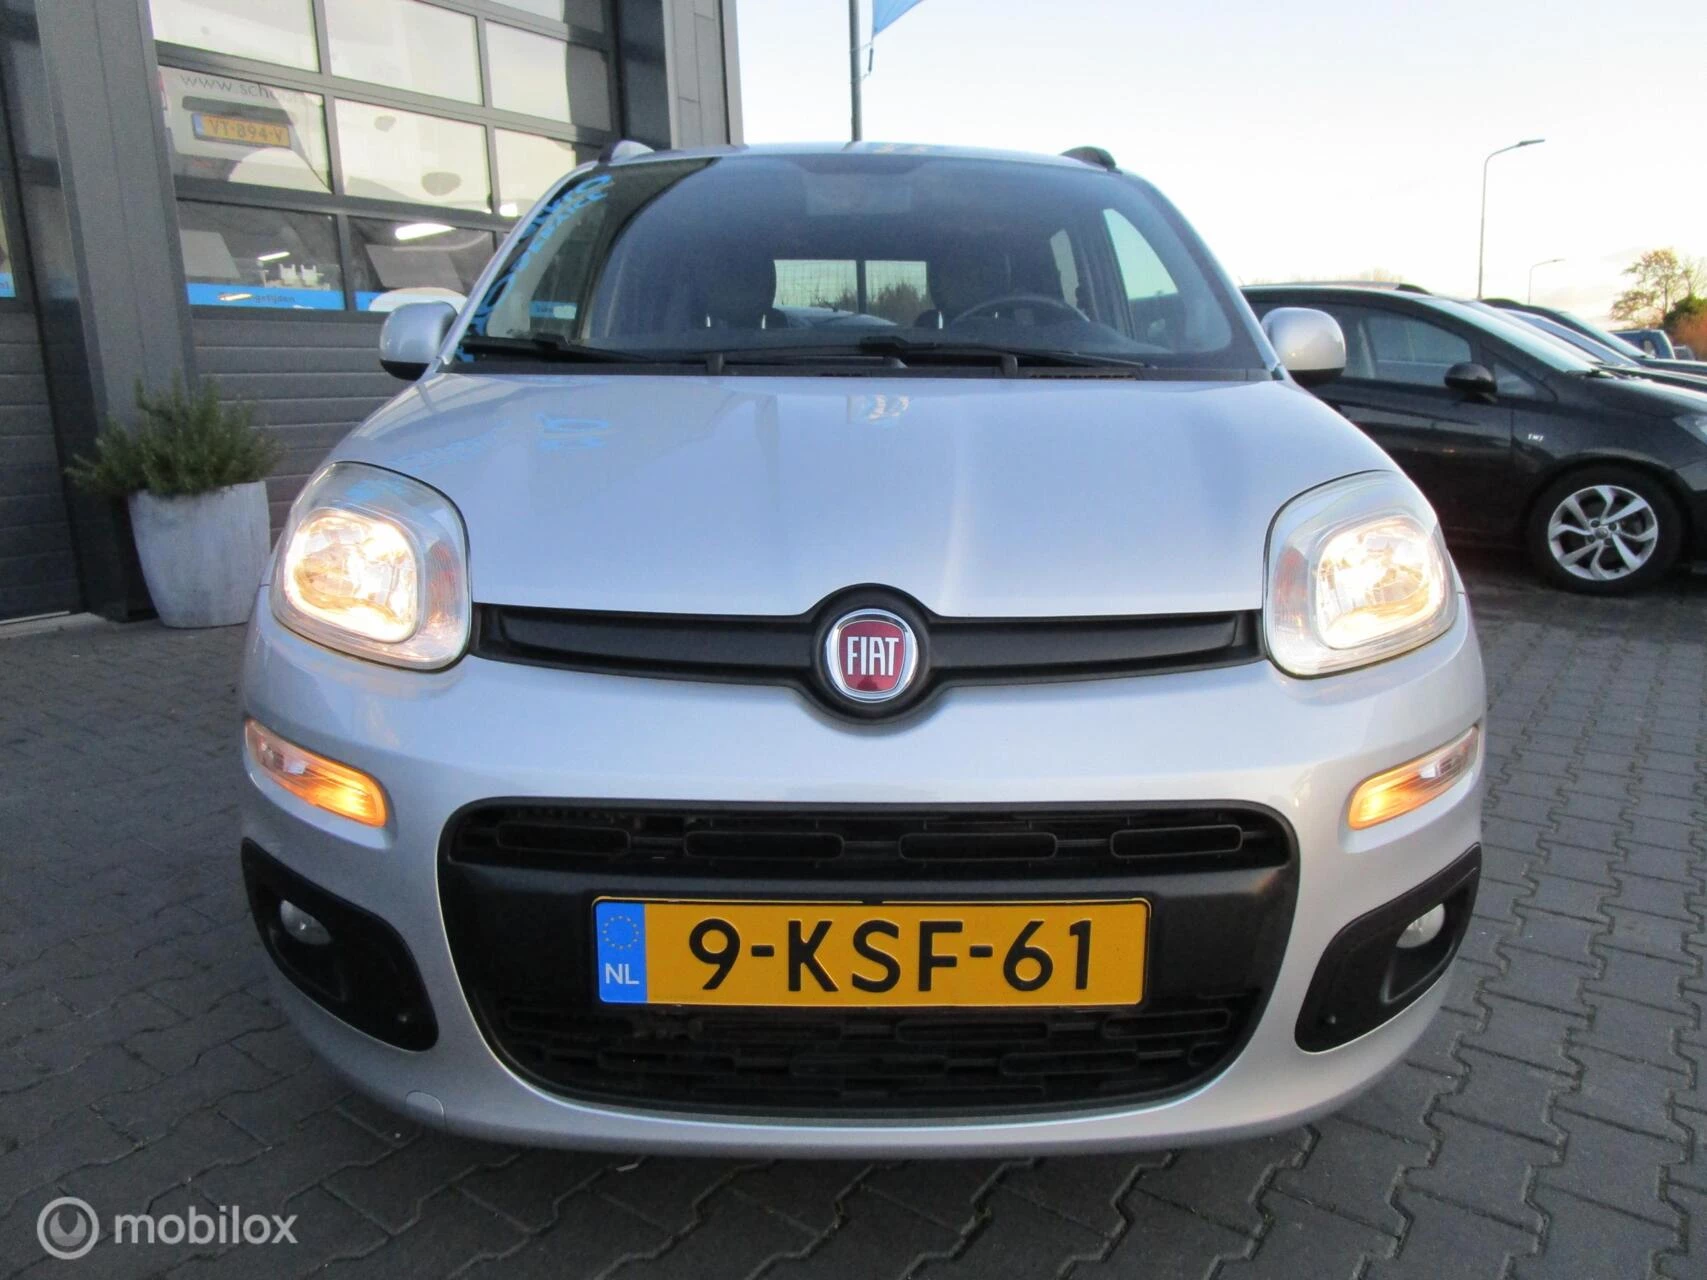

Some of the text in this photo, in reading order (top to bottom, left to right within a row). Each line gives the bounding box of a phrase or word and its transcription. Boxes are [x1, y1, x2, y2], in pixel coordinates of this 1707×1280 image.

[847, 636, 899, 676] FIAT
[605, 963, 640, 985] NL
[688, 918, 1092, 992] 9-KSF-61
